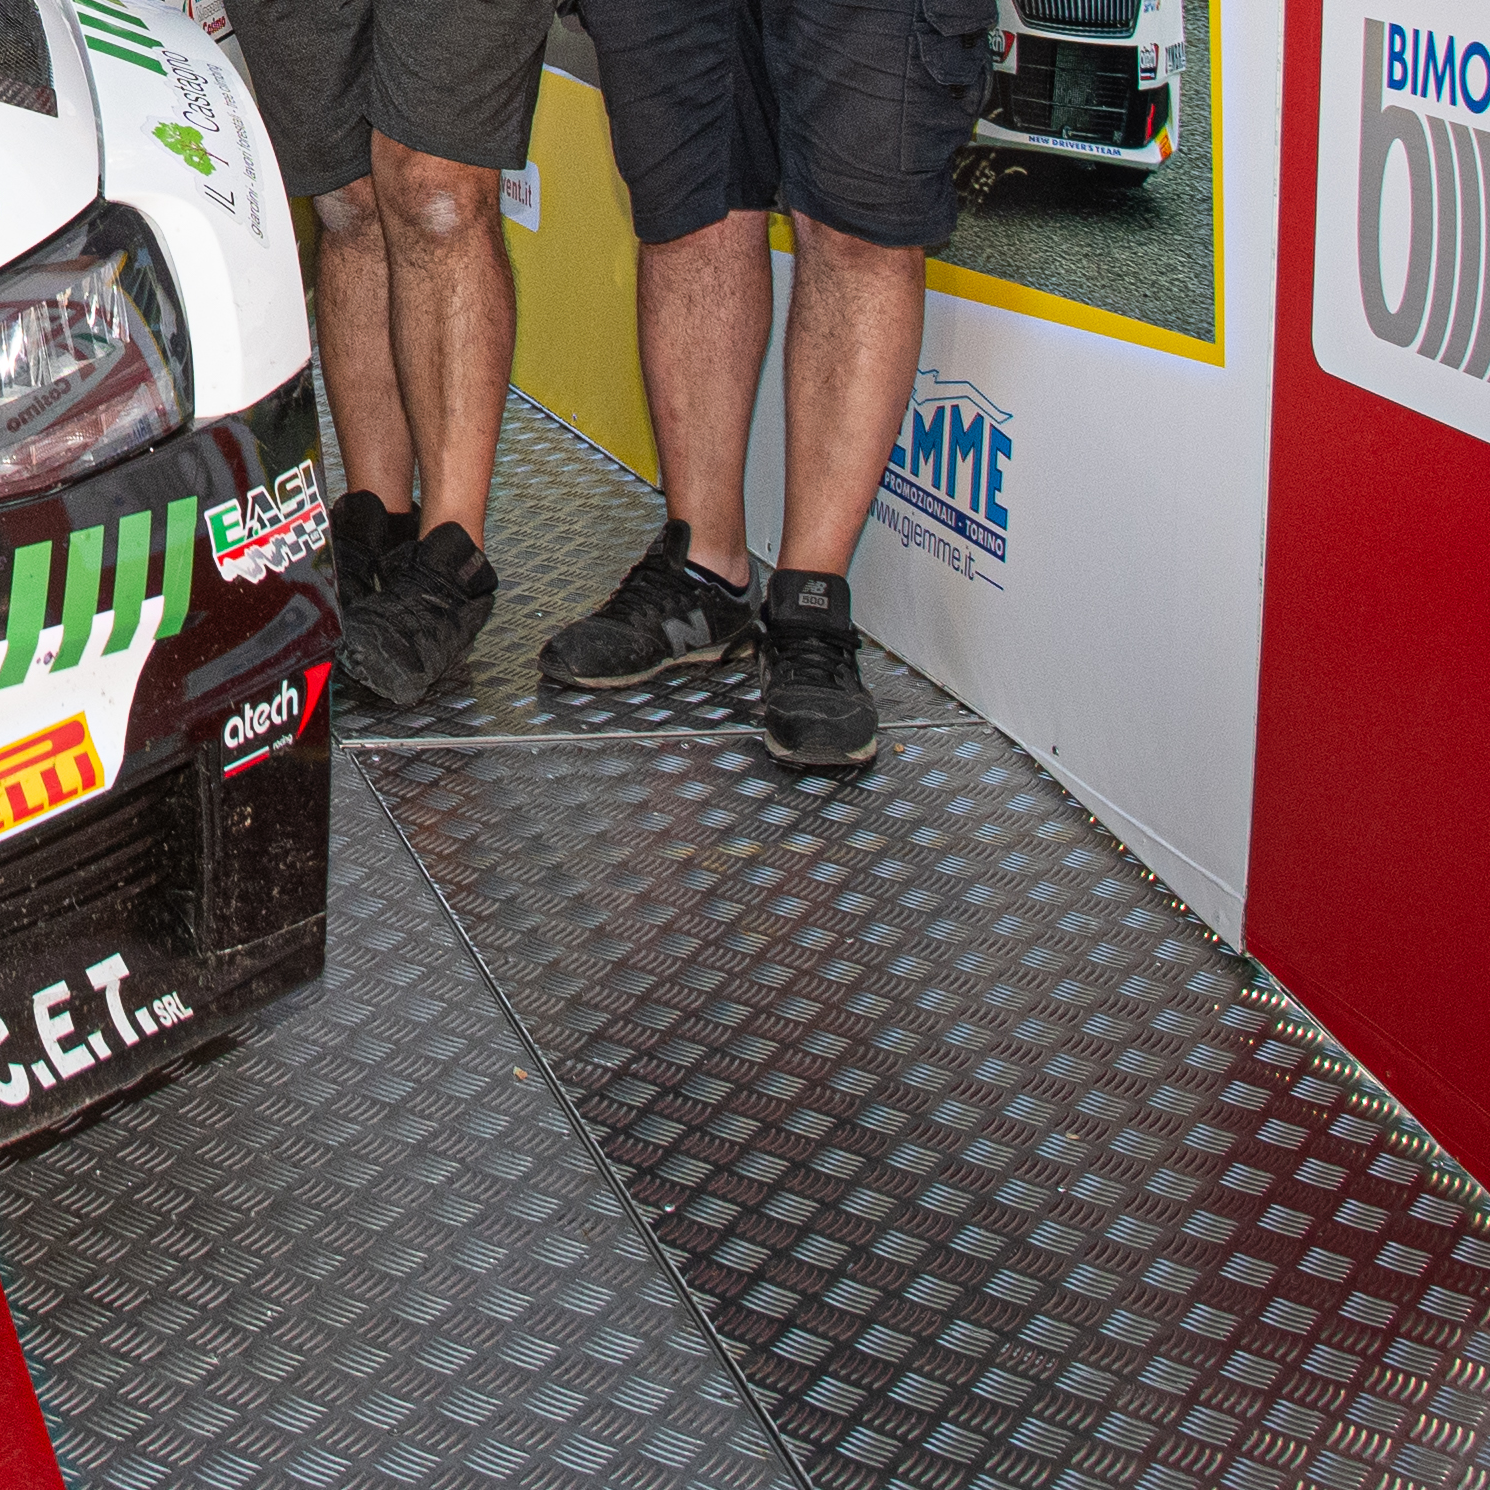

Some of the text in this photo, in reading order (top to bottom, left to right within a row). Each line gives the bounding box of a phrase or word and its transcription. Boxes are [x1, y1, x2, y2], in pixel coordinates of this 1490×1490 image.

[162, 50, 220, 132] Castagno
[1028, 134, 1122, 158] NEW DRIVER'S TEAM
[204, 184, 235, 214] IL
[246, 187, 264, 239] giardini
[884, 470, 1005, 558] PROMOZIONALI TORINO
[801, 594, 825, 607] 500
[223, 679, 298, 749] atech
[152, 990, 194, 1028] SRL
